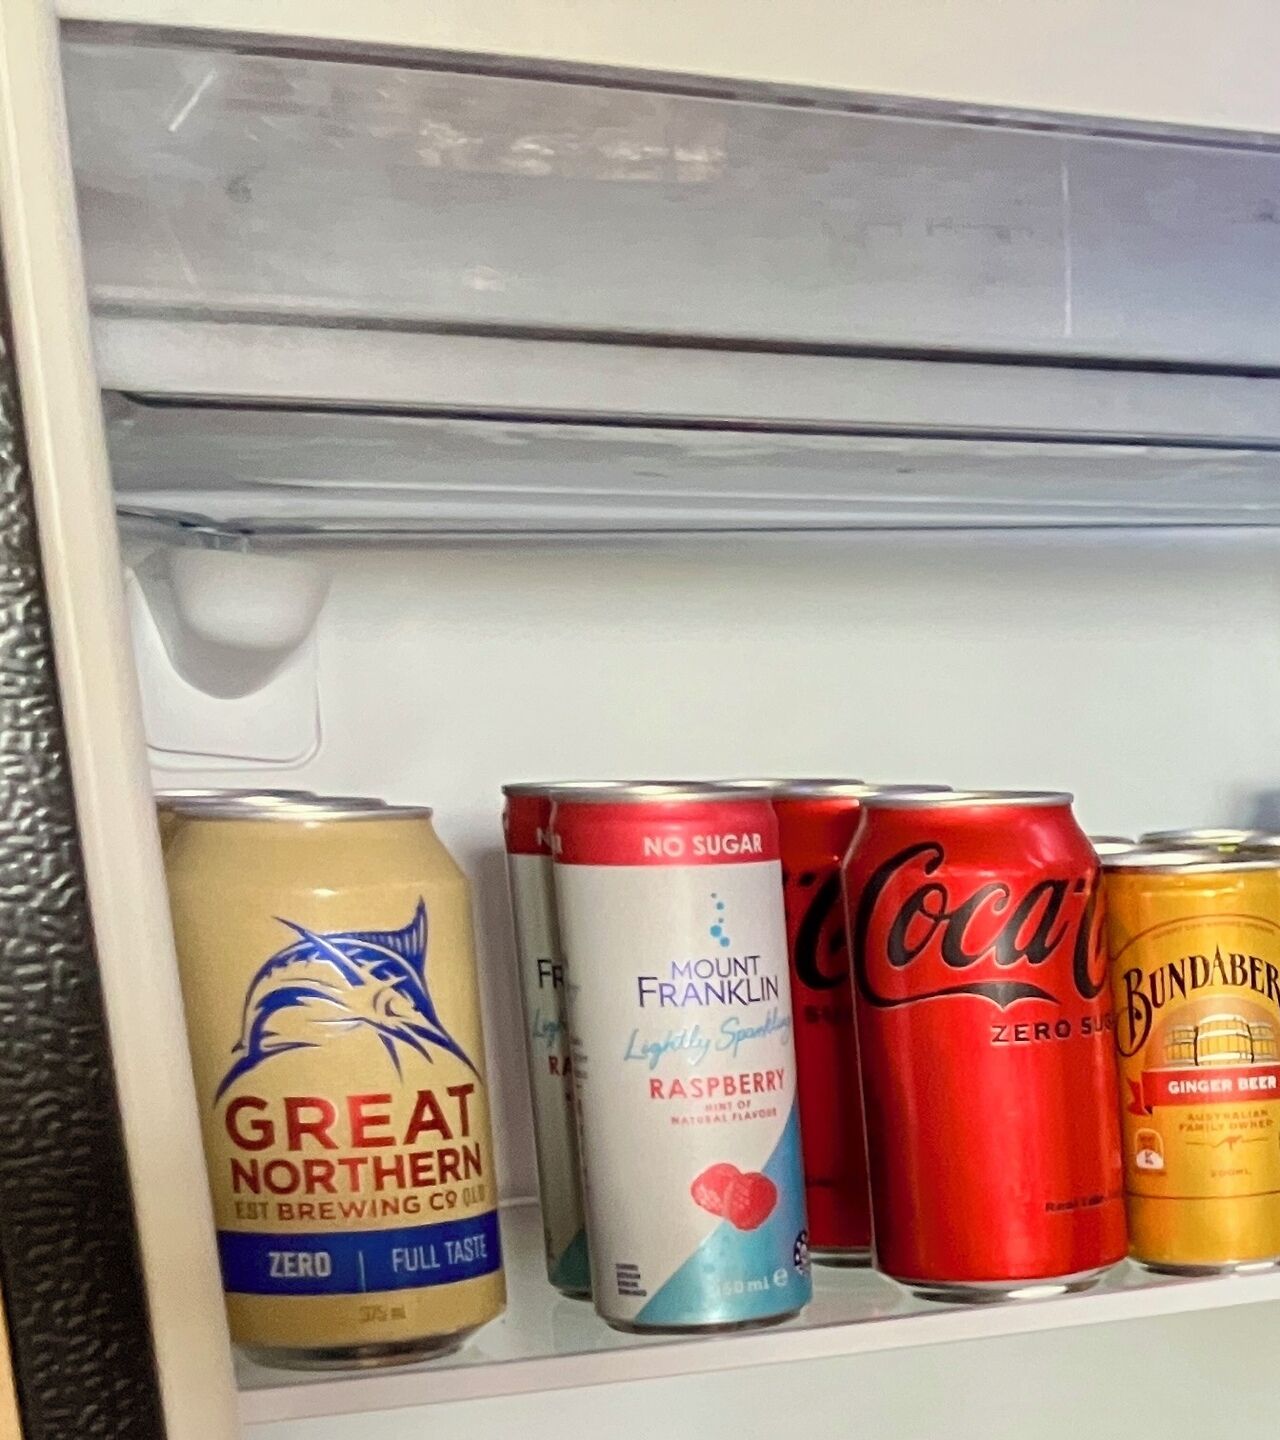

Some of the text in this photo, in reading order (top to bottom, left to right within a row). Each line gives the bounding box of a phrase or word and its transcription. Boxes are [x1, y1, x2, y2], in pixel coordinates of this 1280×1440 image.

[643, 832, 763, 858] NO SUGAR
[671, 955, 761, 981] MOUNT
[637, 975, 780, 1009] FRANKLIN
[623, 1022, 710, 1071] Lightly
[990, 1019, 1071, 1047] ZERO
[649, 1067, 786, 1101] RASPBERRY
[1168, 1075, 1277, 1095] GINGER BEER
[225, 1083, 475, 1151] GREAT
[737, 1099, 752, 1110] OF
[670, 1113, 729, 1127] NATURAL
[230, 1142, 483, 1195] NORTHERN
[277, 1195, 421, 1222] BREWING
[268, 1233, 489, 1278] ZERO FULL TASTE
